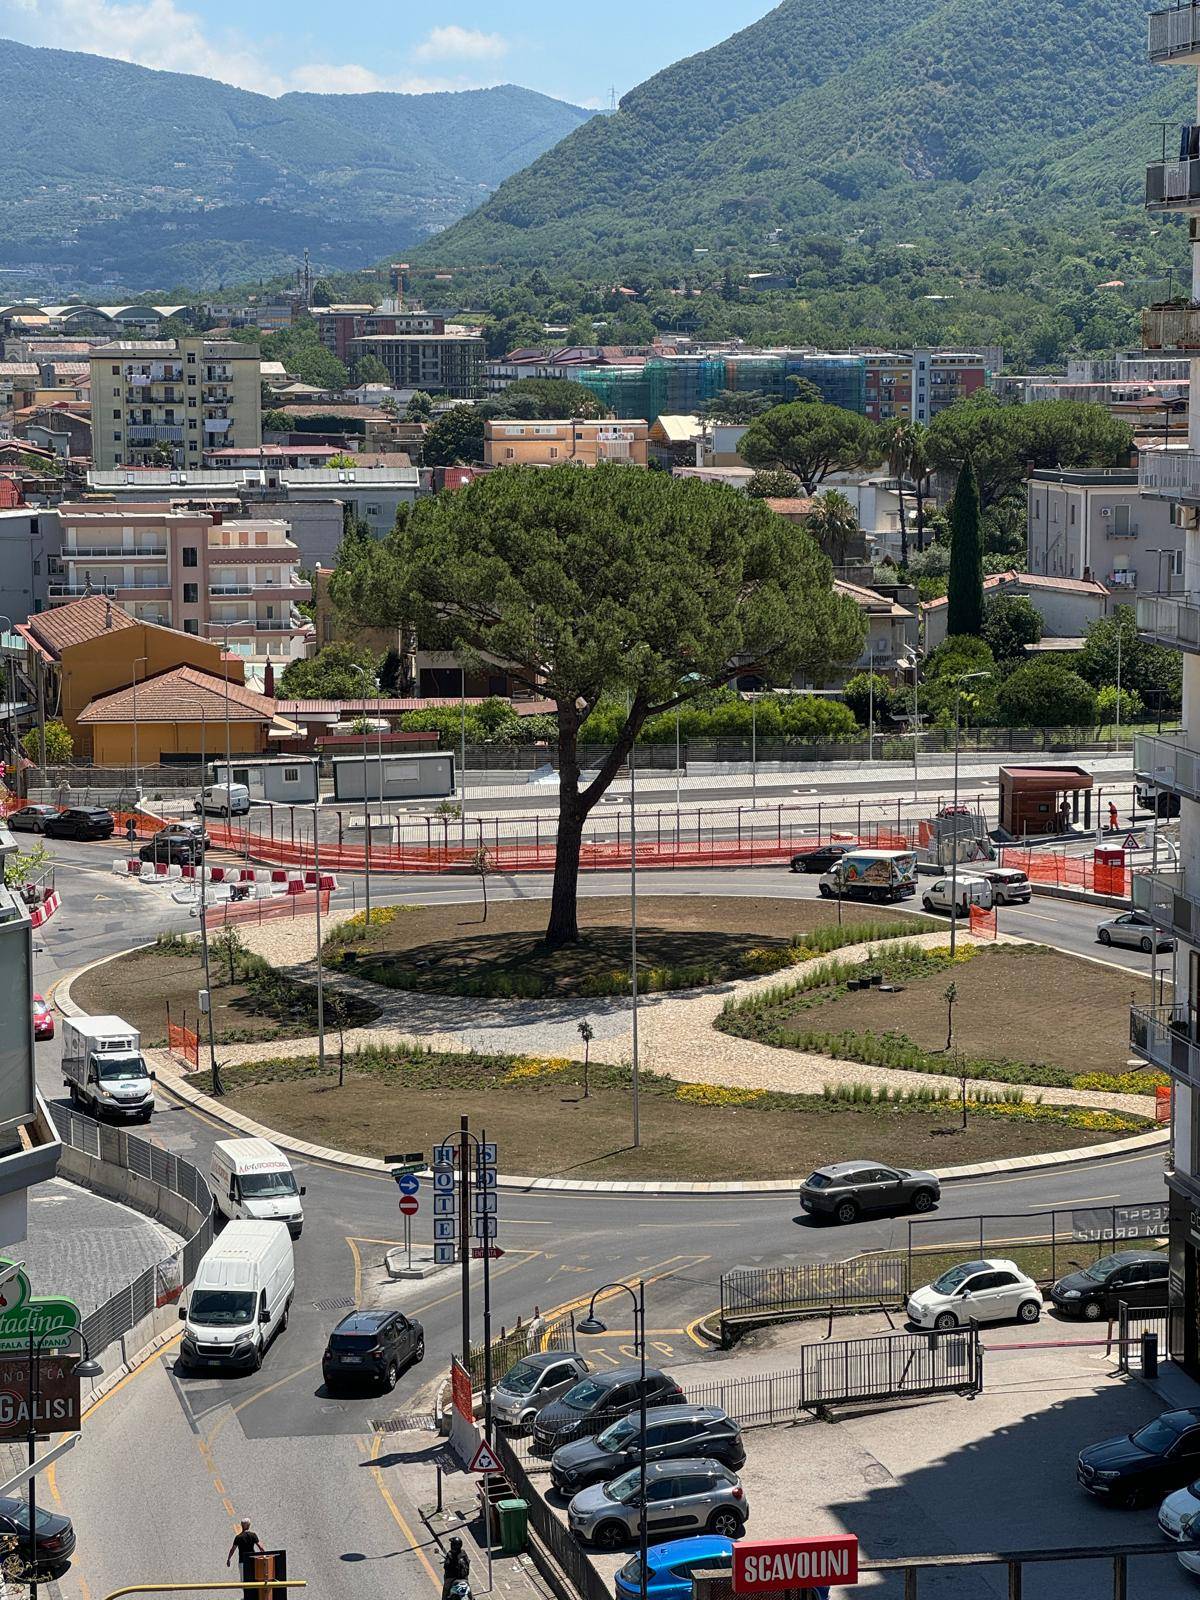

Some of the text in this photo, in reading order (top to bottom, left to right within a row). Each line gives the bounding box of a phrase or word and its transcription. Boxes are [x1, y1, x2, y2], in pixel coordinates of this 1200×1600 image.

[480, 1148, 494, 1234] SOLE
[437, 1149, 451, 1261] HOTEL
[474, 1249, 497, 1257] ENTATA
[0, 1339, 67, 1350] FALA CAMPANA
[4, 1368, 64, 1382] NOCA
[0, 1396, 73, 1422] GALISI
[744, 1549, 849, 1583] SCAVOLINI
